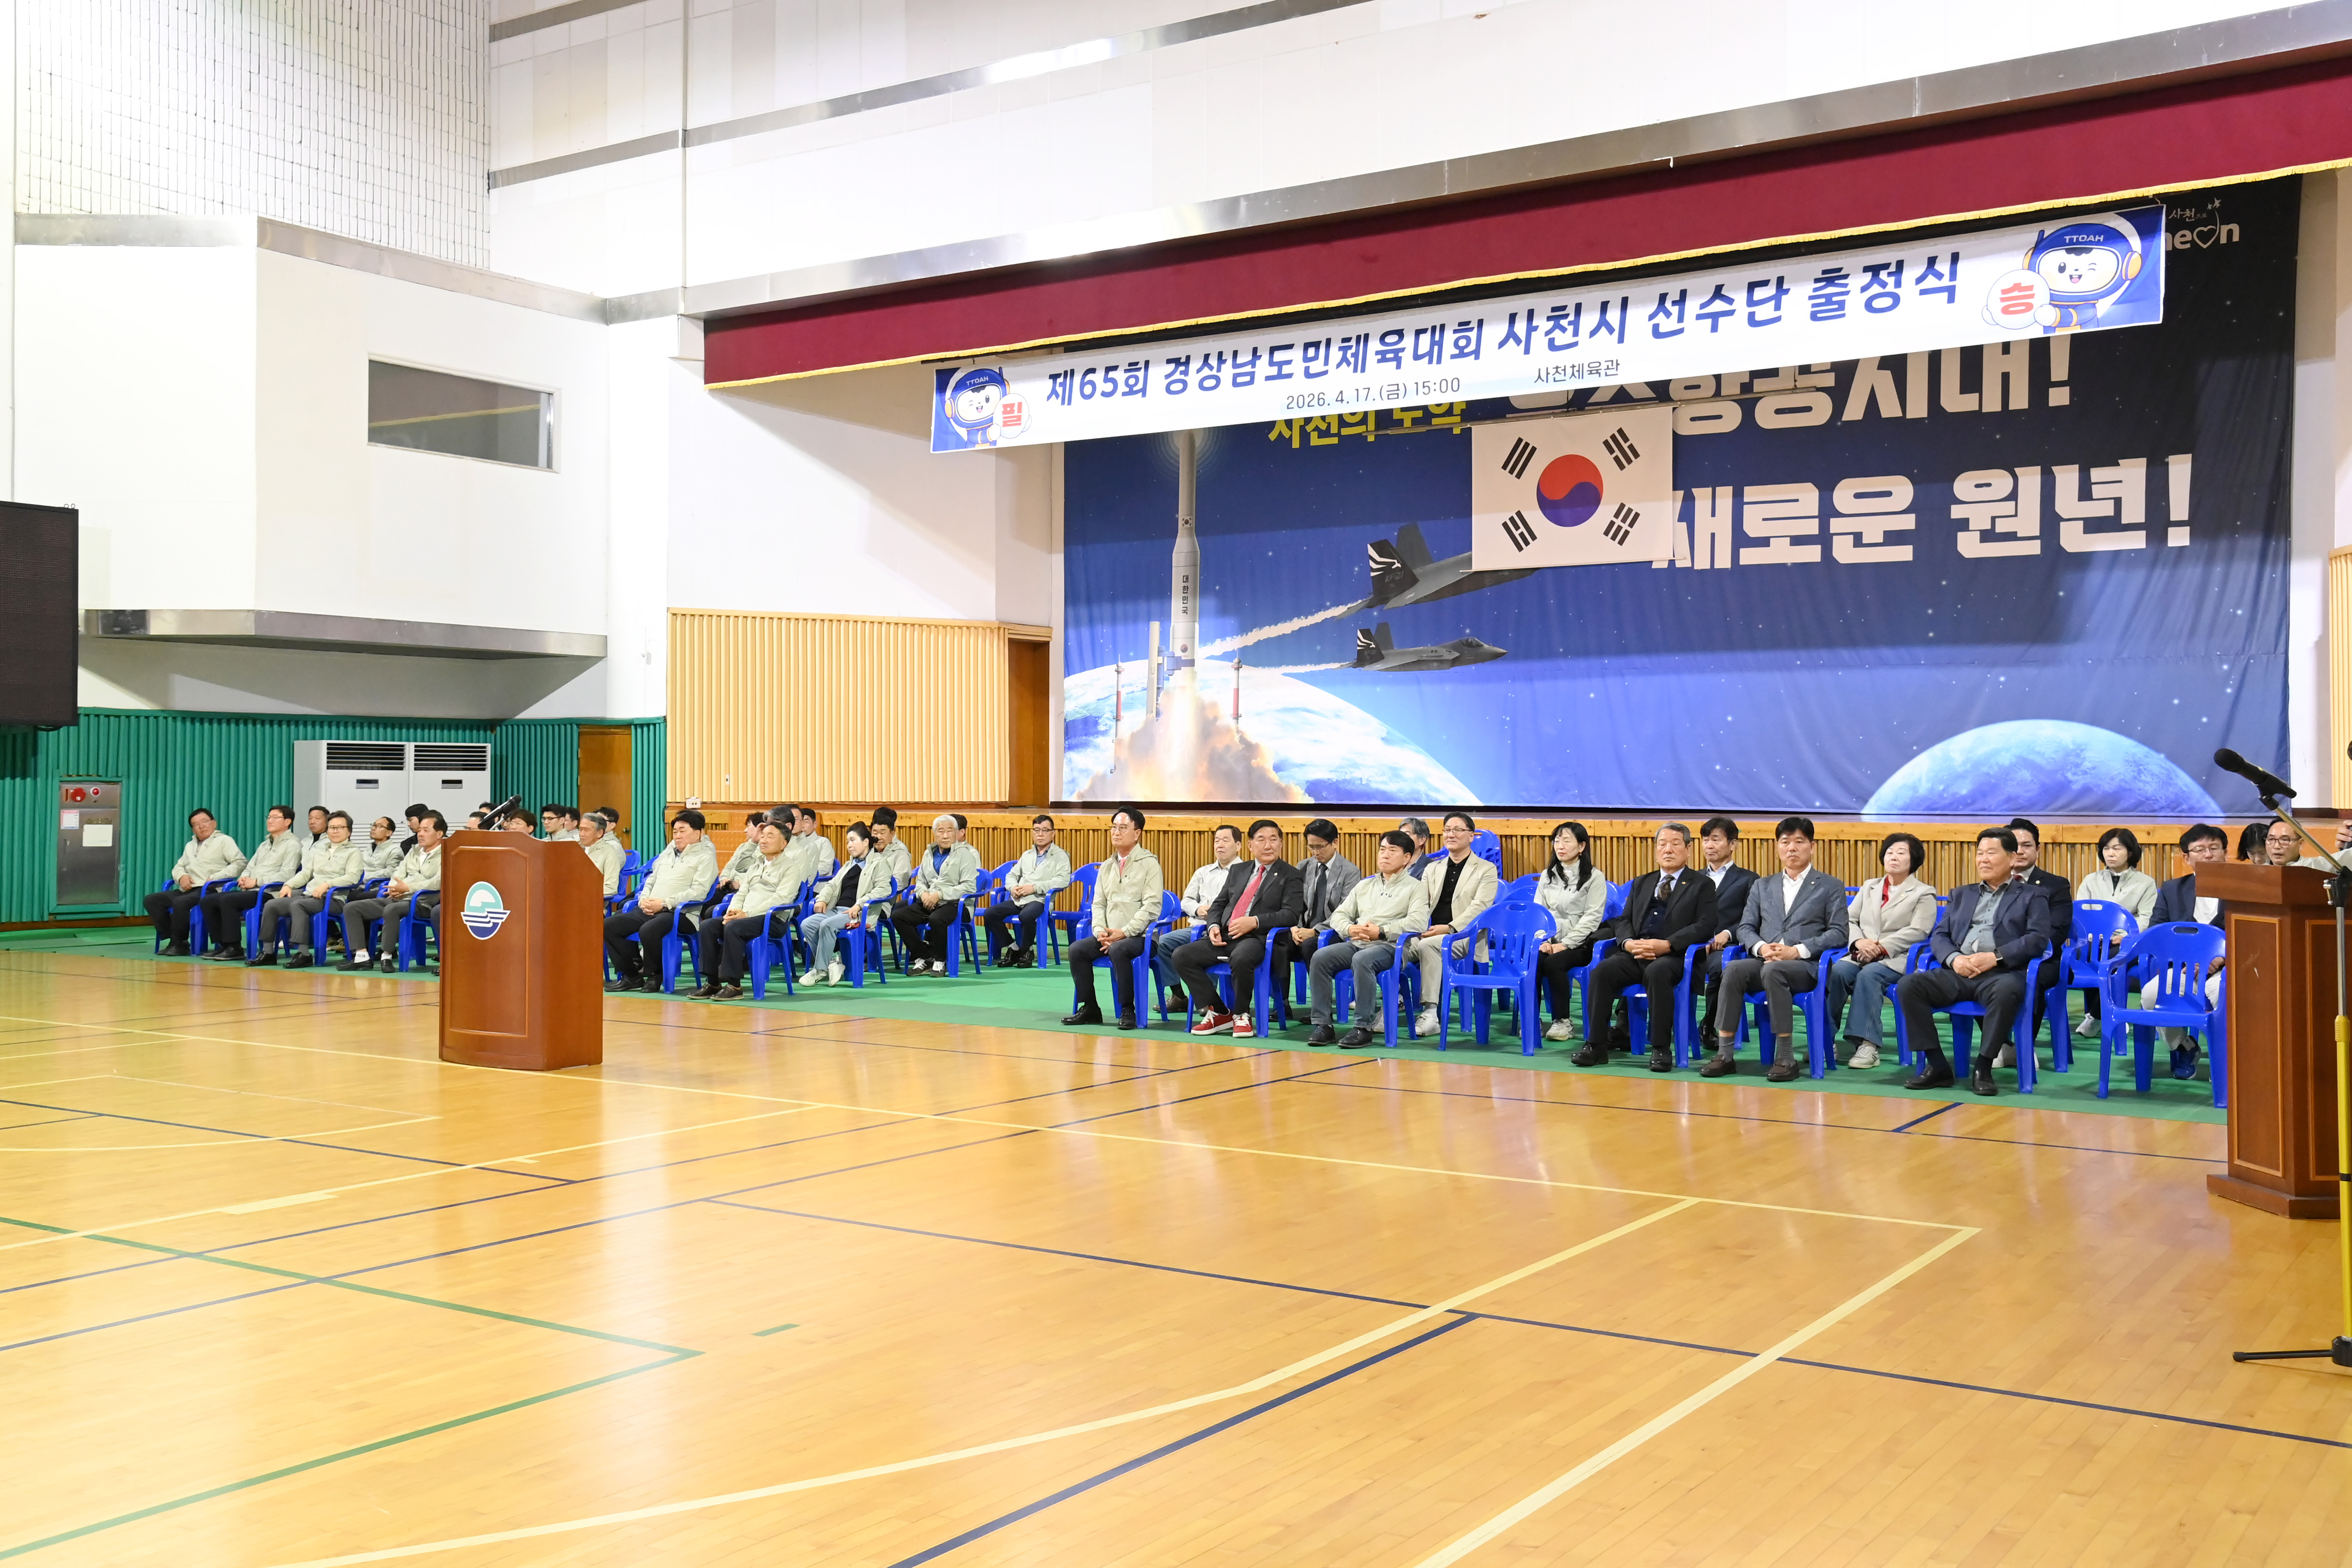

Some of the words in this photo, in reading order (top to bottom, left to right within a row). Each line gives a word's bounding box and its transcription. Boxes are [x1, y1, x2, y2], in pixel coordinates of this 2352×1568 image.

[2064, 234, 2104, 243] TTOAH
[1999, 282, 2036, 316] 승
[1047, 359, 1150, 406] 제65회
[1164, 318, 1484, 395] 경상남도민체육대회
[1498, 296, 1629, 355] 사천시
[1648, 275, 1791, 339] 선수단
[1808, 251, 1960, 322] 출정식
[966, 376, 988, 386] TTOAH
[1534, 359, 1620, 384] 사천체육관
[1286, 391, 1330, 410] 2026.
[1414, 377, 1460, 396] 15:00
[1002, 401, 1023, 427] 필
[1950, 453, 2192, 558] 원년!
